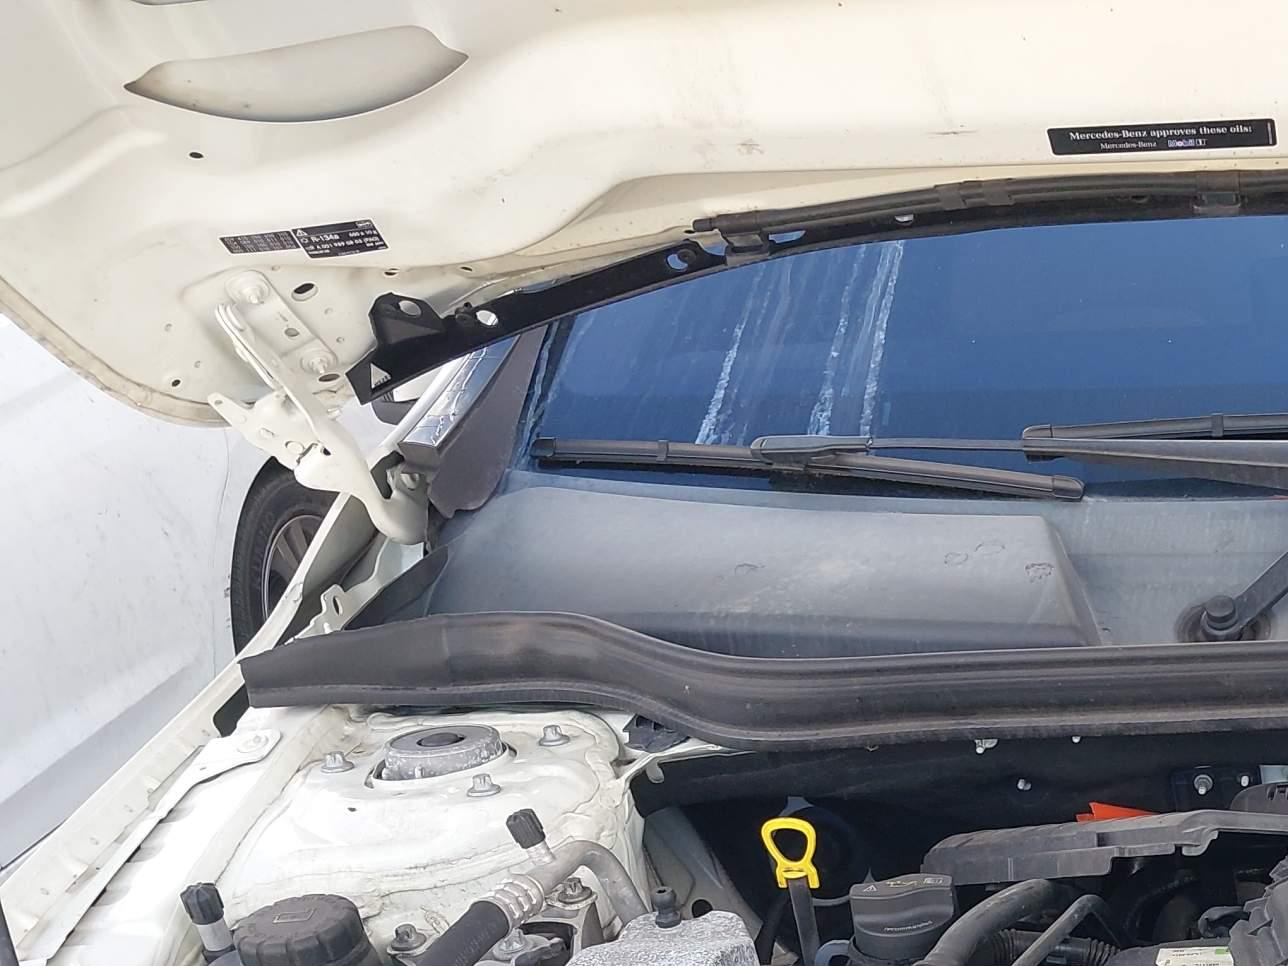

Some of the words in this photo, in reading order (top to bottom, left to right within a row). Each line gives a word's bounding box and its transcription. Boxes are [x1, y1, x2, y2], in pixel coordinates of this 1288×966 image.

[1069, 129, 1148, 141] Mercedes-Benz
[1150, 128, 1197, 139] approves
[1199, 126, 1228, 135] these
[310, 234, 340, 242] R-134a
